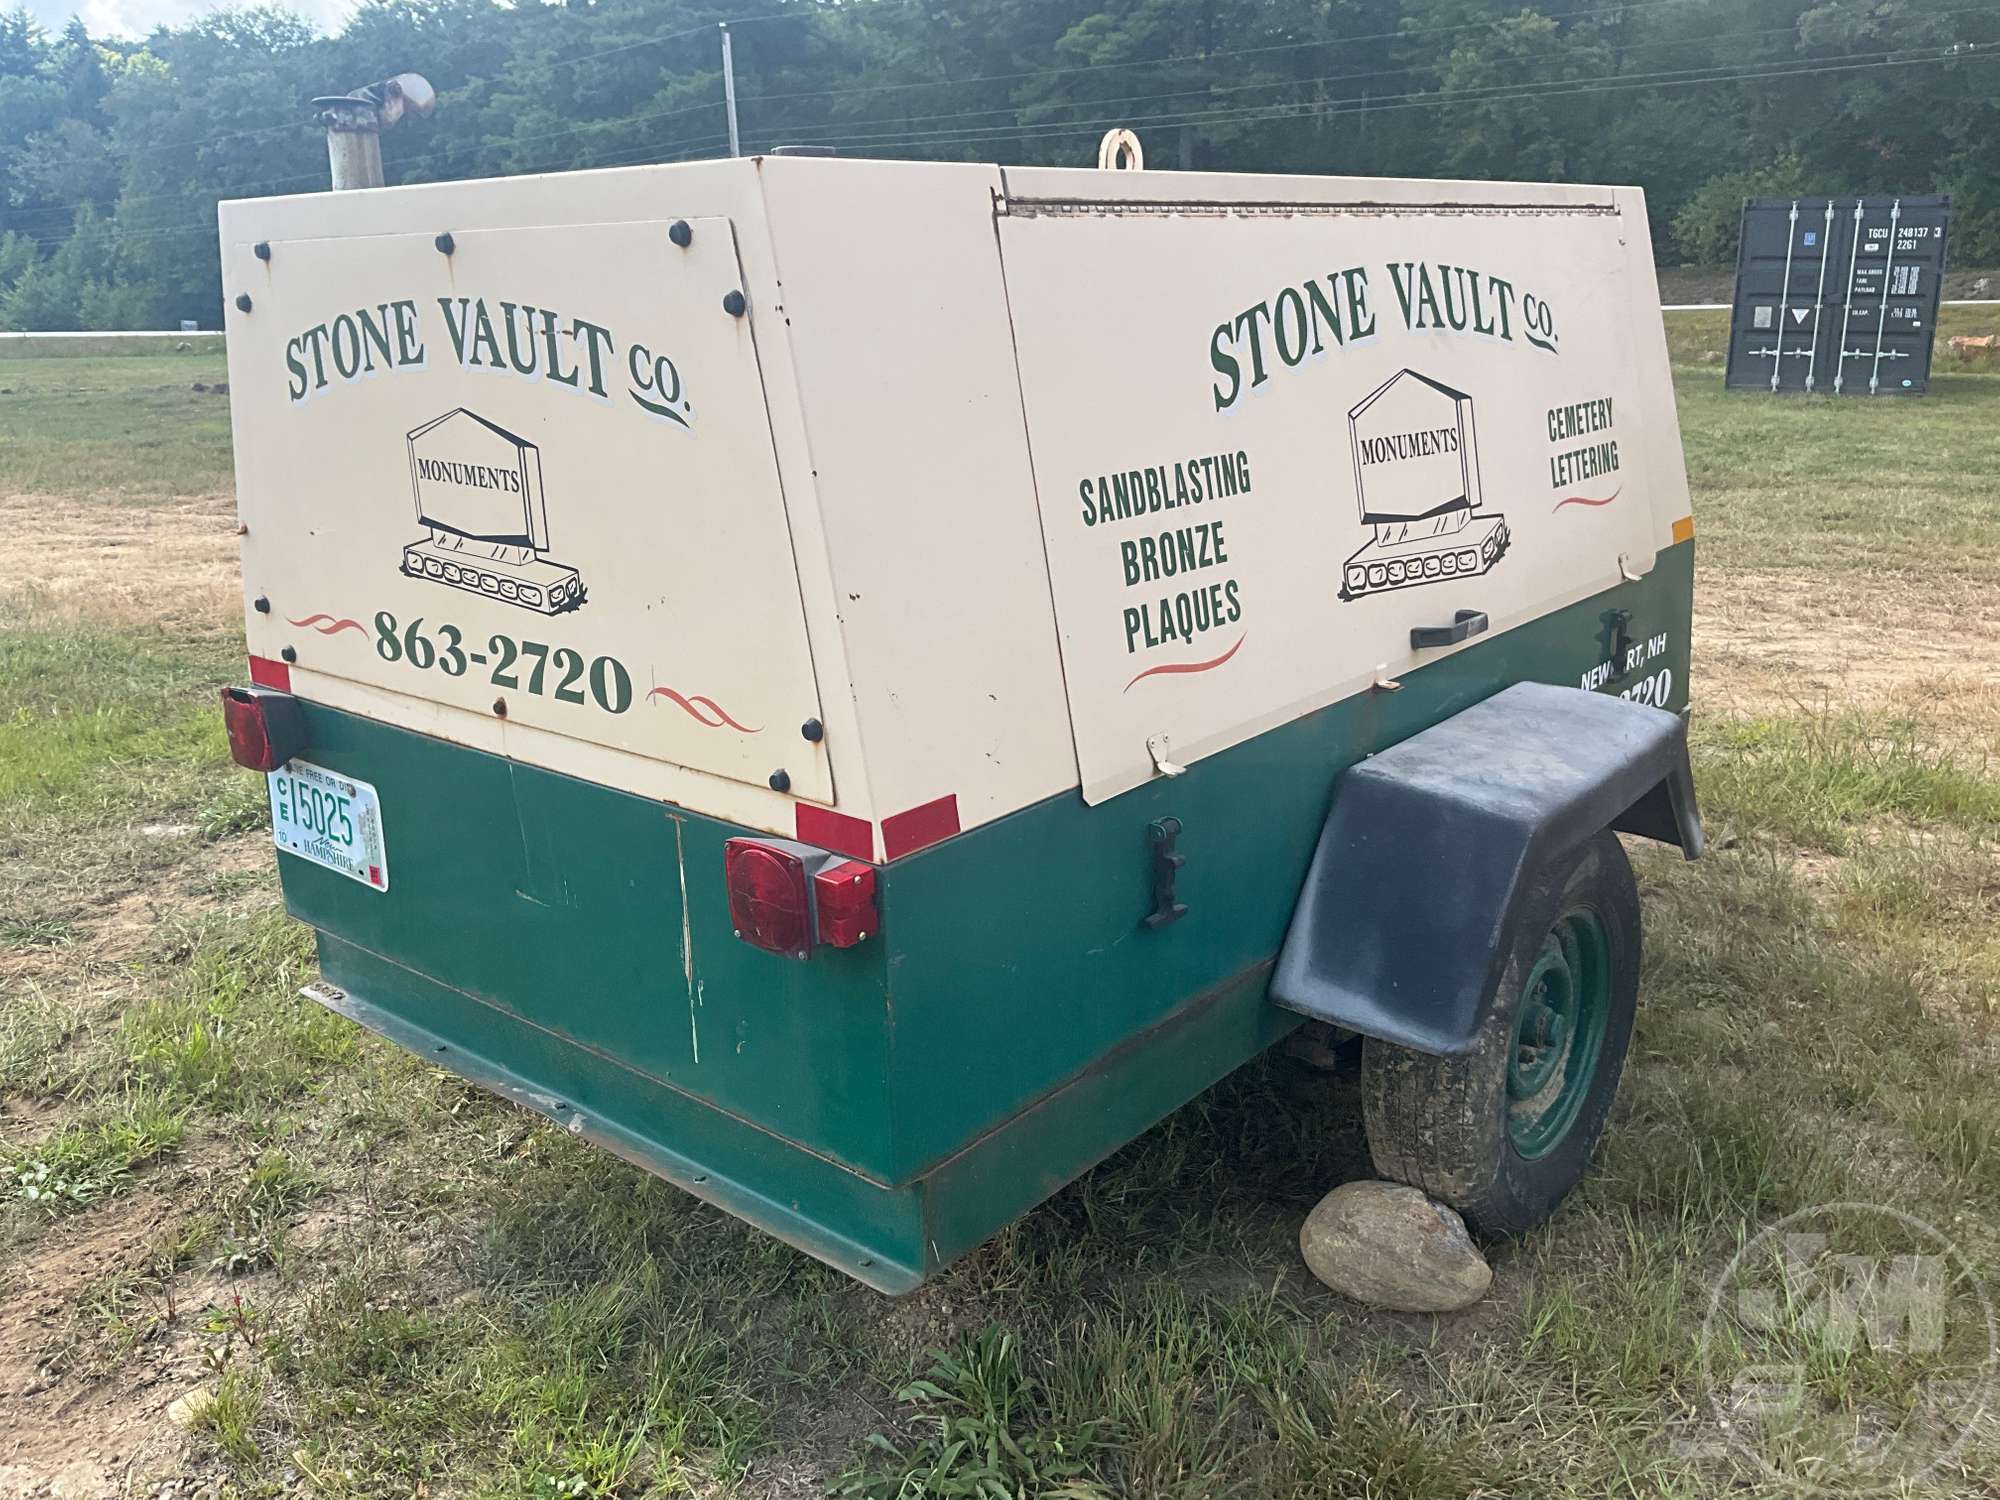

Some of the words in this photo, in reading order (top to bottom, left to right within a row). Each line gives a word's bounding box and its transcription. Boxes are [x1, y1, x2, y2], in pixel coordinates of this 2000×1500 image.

[1868, 228, 1889, 239] TGCU
[1897, 227, 1929, 238] 248137
[1934, 226, 1942, 239] 3
[286, 299, 424, 402] STONE
[437, 297, 614, 398] VAULT
[629, 344, 690, 413] CO.
[1210, 266, 1376, 413] STONE
[1386, 260, 1516, 342] VAULT
[1523, 293, 1559, 342] CO.
[1360, 427, 1459, 466] MONUMENTS
[1547, 397, 1613, 442] CEMETERY
[418, 457, 521, 494] MONUMENTS
[1079, 450, 1252, 527] SANDBLASTING
[1550, 440, 1620, 489] LETTERING
[1120, 520, 1228, 587] BRONZE
[1123, 579, 1242, 654] PLAQUES
[374, 610, 633, 714] 863-2720
[1581, 643, 1645, 691] NEWRT,
[1647, 632, 1667, 660] NH
[305, 767, 324, 783] FREE
[326, 775, 336, 790] OR
[303, 838, 354, 871] HAMPSHIRE
